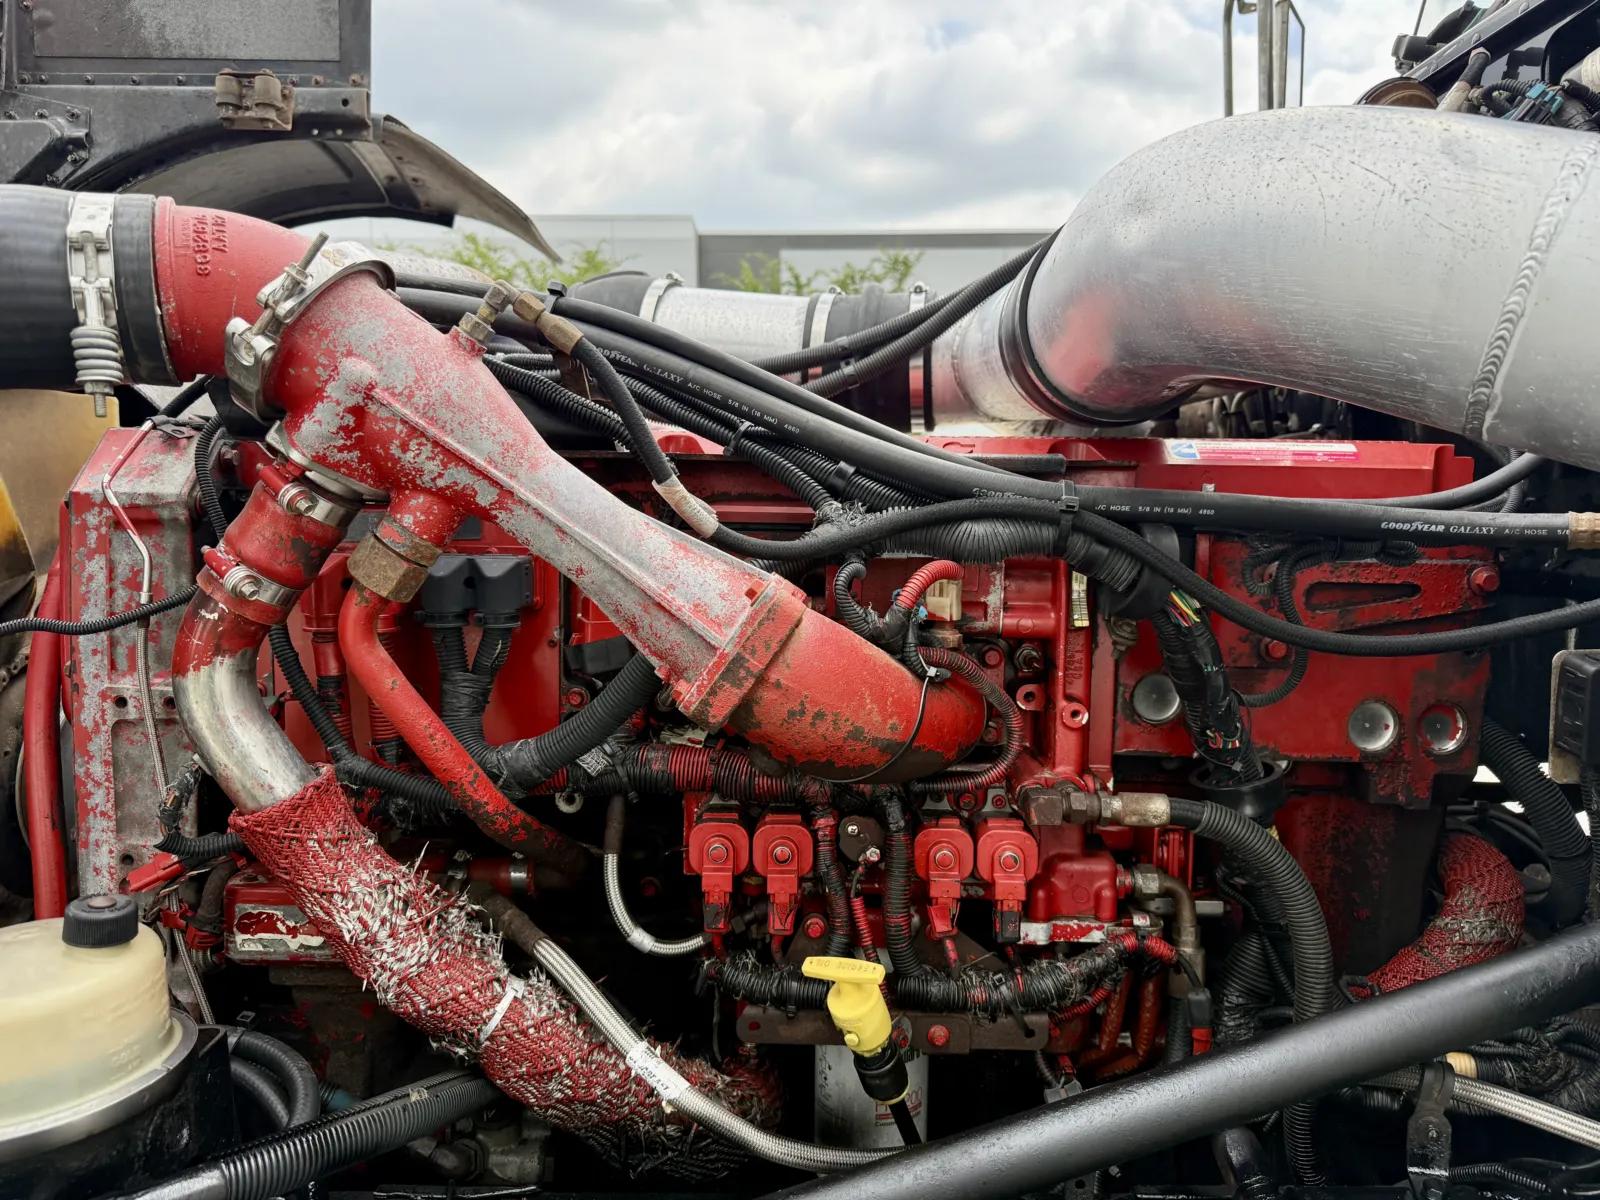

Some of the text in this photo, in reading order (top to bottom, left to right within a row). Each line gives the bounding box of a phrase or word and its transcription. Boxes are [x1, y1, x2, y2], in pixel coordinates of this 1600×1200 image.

[687, 381, 701, 391] A/C
[703, 388, 722, 401] HOSE
[728, 399, 739, 409] 5/8
[742, 404, 749, 413] IN
[763, 413, 778, 425] MM)
[1110, 504, 1131, 512] HOSE
[1177, 507, 1192, 515] MM)
[1380, 521, 1444, 533] GOODYEAR
[1450, 525, 1497, 535] GALAXY
